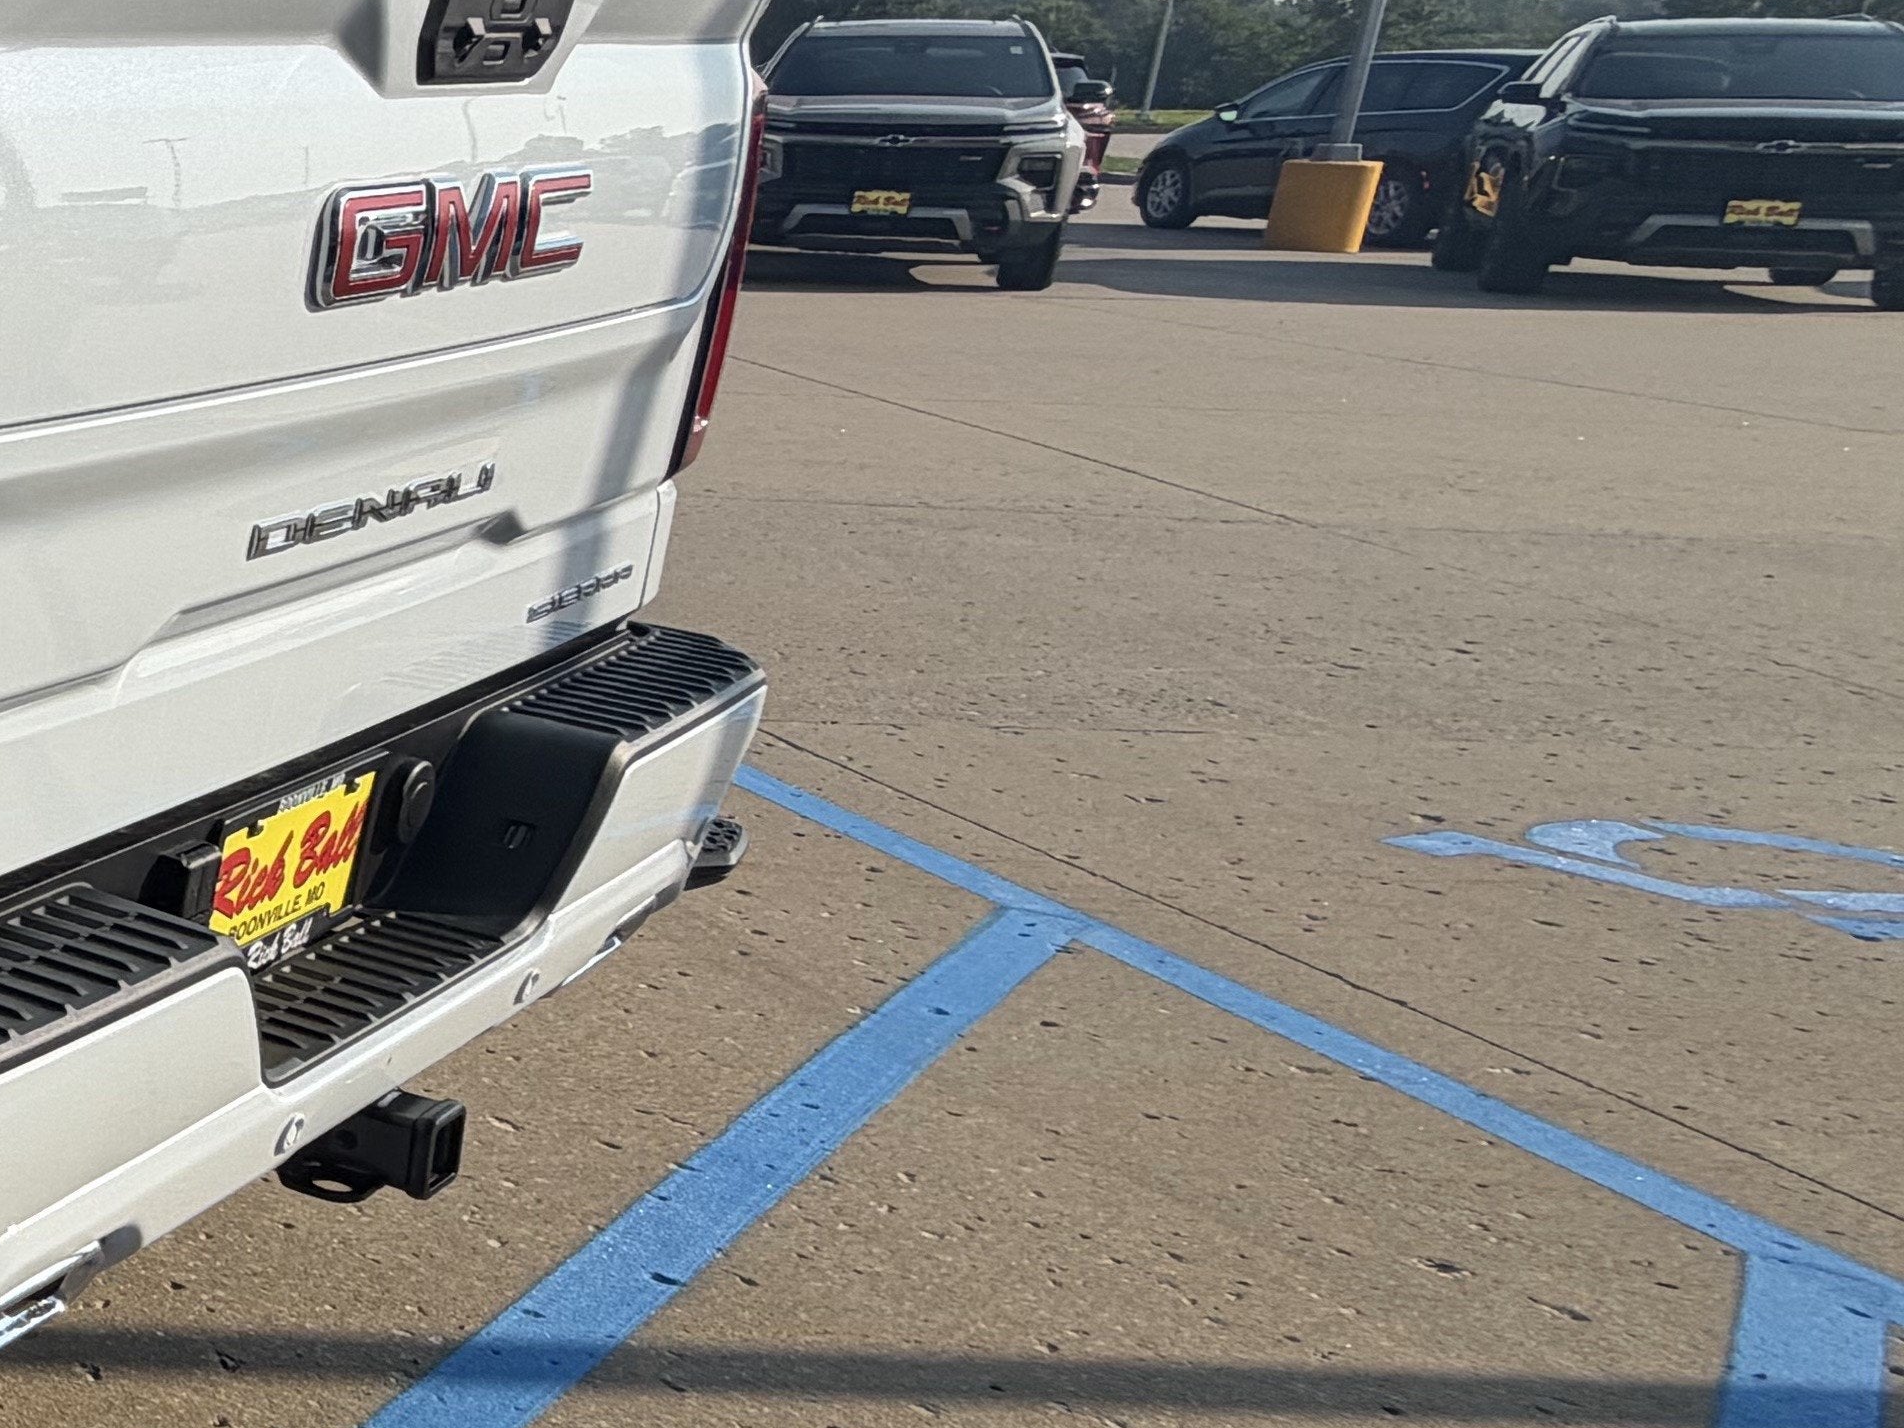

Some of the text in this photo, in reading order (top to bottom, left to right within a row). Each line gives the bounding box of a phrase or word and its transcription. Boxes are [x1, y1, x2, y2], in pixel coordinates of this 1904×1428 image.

[304, 162, 592, 313] GMC
[246, 461, 496, 562] DENALI
[213, 800, 369, 920] Rick Ball
[304, 881, 326, 906] MO
